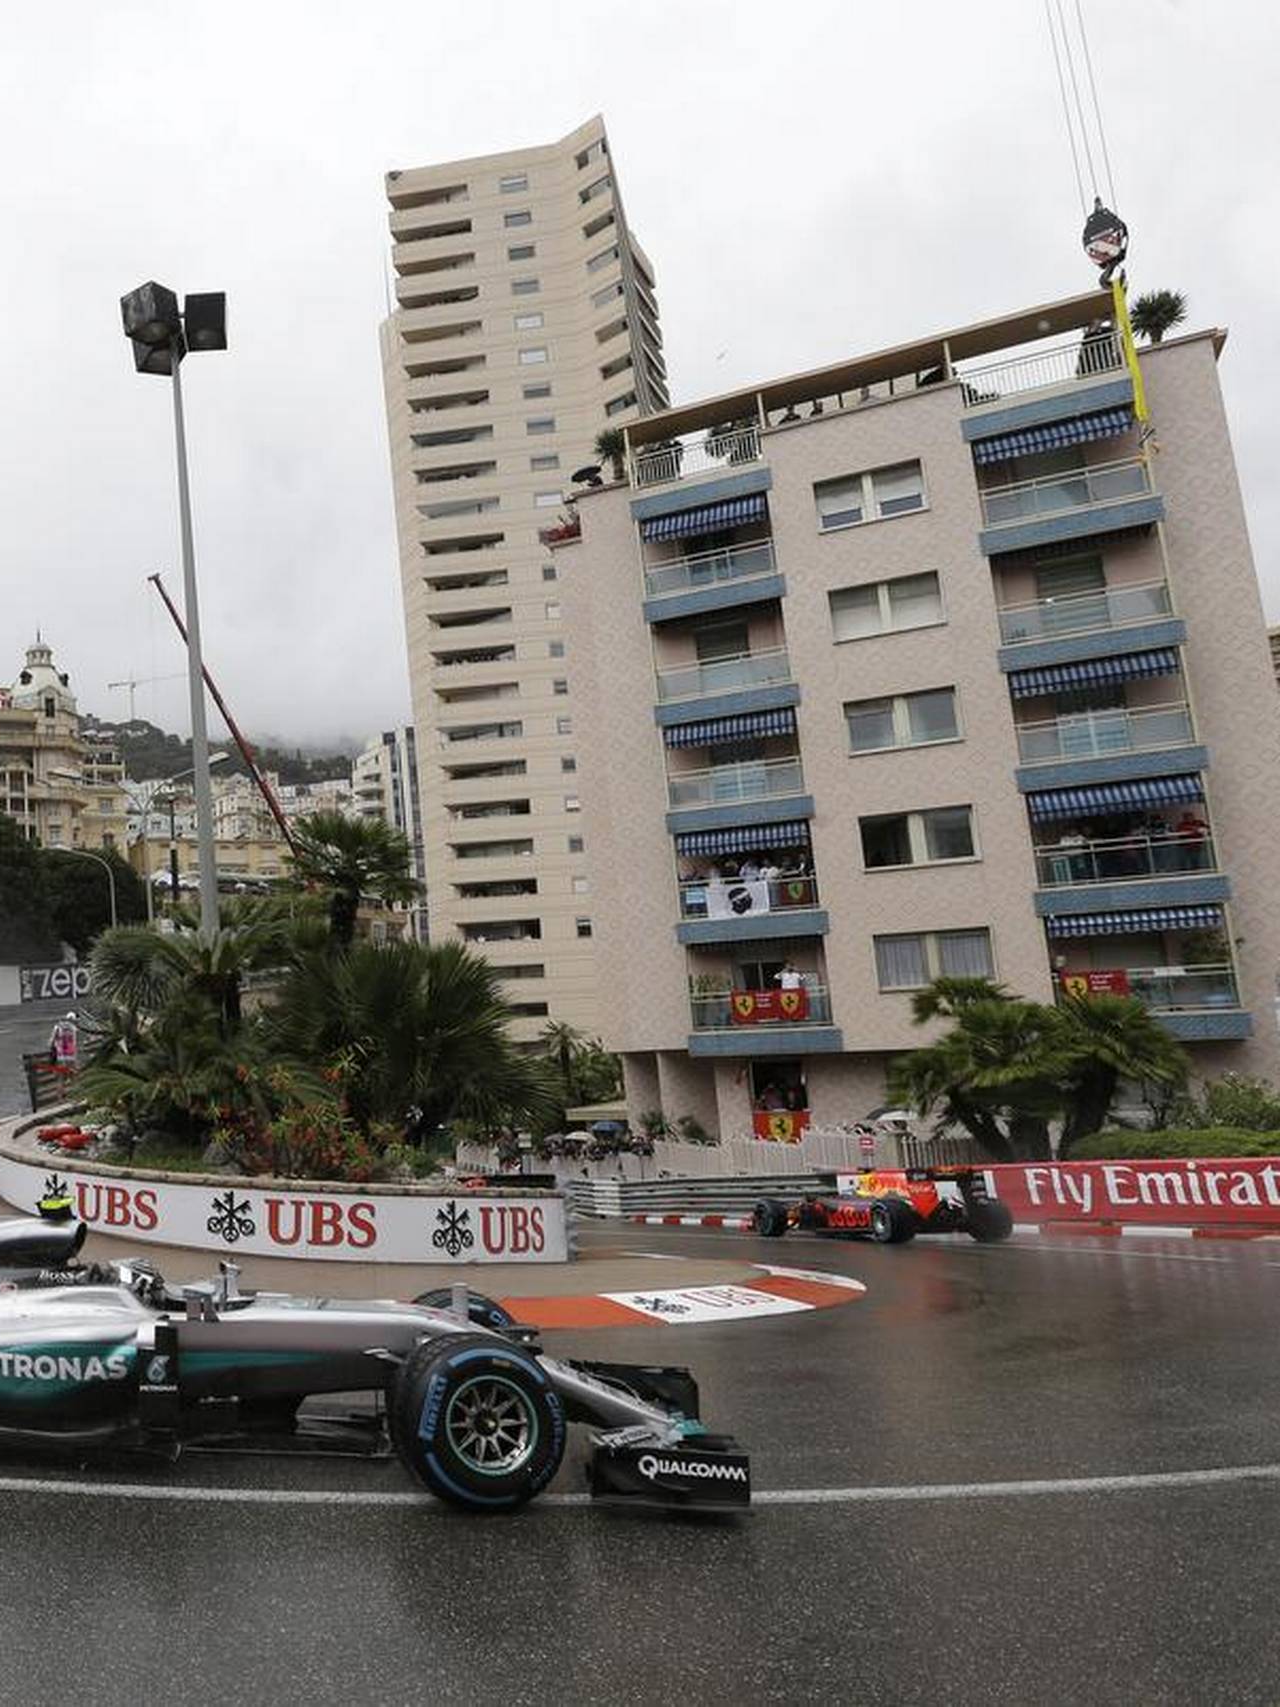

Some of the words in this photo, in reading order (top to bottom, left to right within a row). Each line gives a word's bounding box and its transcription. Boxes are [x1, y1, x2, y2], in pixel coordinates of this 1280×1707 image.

[76, 1182, 158, 1230] UBS
[1024, 1168, 1092, 1213] Fly
[265, 1199, 377, 1248] UBS
[480, 1206, 545, 1255] UBS
